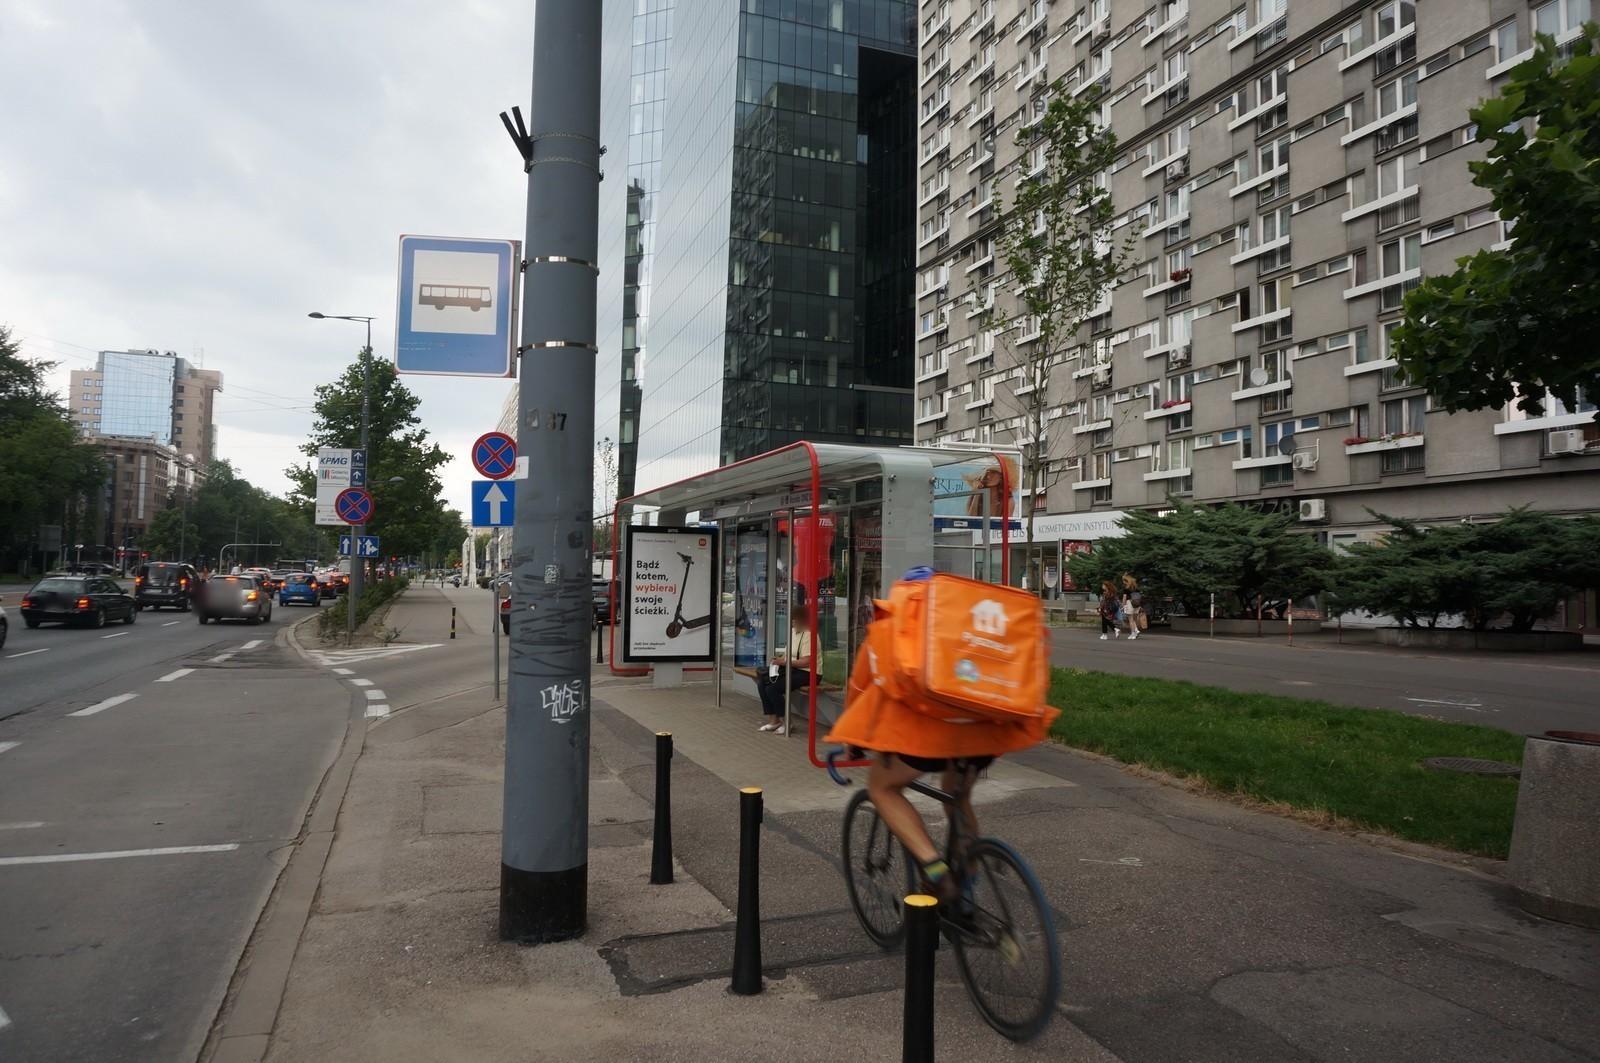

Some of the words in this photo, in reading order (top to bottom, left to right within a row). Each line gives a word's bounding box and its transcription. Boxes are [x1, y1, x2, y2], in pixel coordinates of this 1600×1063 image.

[320, 457, 348, 465] KPMG
[1038, 522, 1082, 533] KOSMETYCZNY
[636, 560, 660, 570] Bądź
[635, 571, 669, 582] kotem,
[635, 583, 677, 594] wybieraj
[634, 595, 663, 605] swoje
[634, 606, 670, 615] ścieżki.
